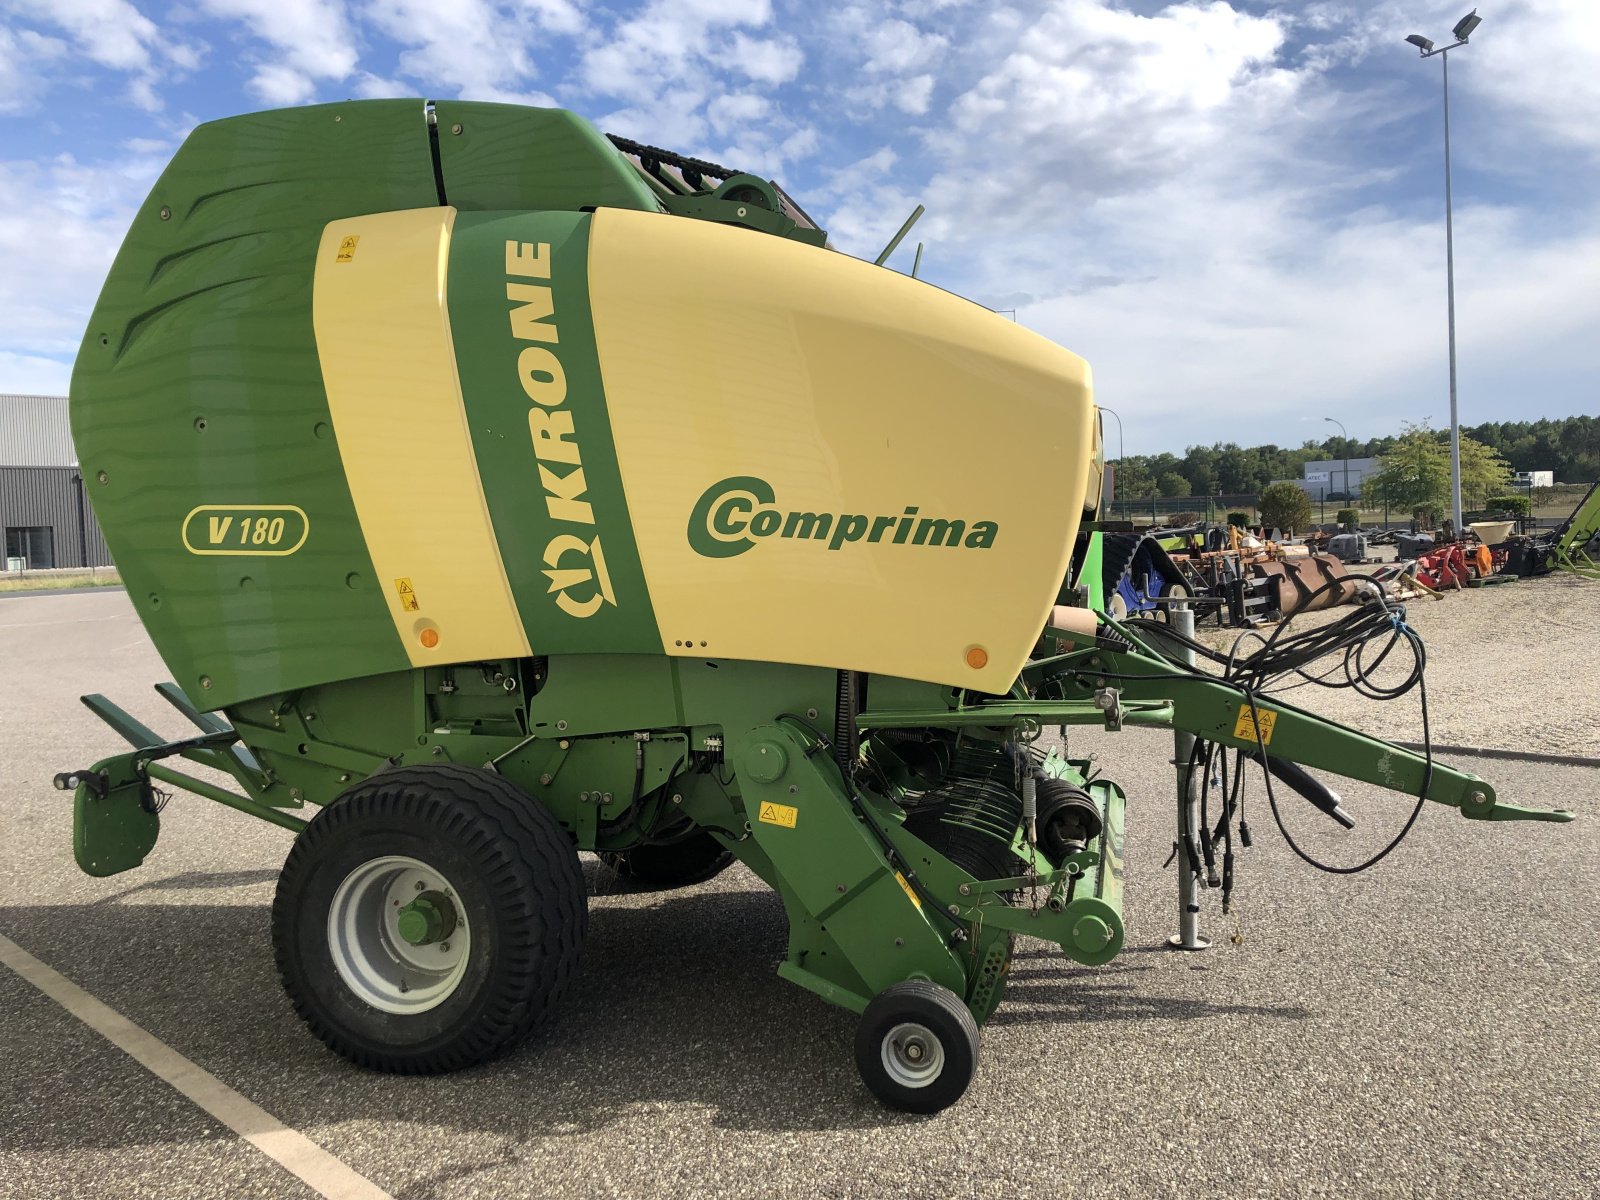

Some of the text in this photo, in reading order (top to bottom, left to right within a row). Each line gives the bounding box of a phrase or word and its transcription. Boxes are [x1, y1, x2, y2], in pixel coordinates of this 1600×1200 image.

[505, 239, 595, 525] KRONE
[209, 516, 285, 545] V 180
[687, 476, 999, 558] Comprima
